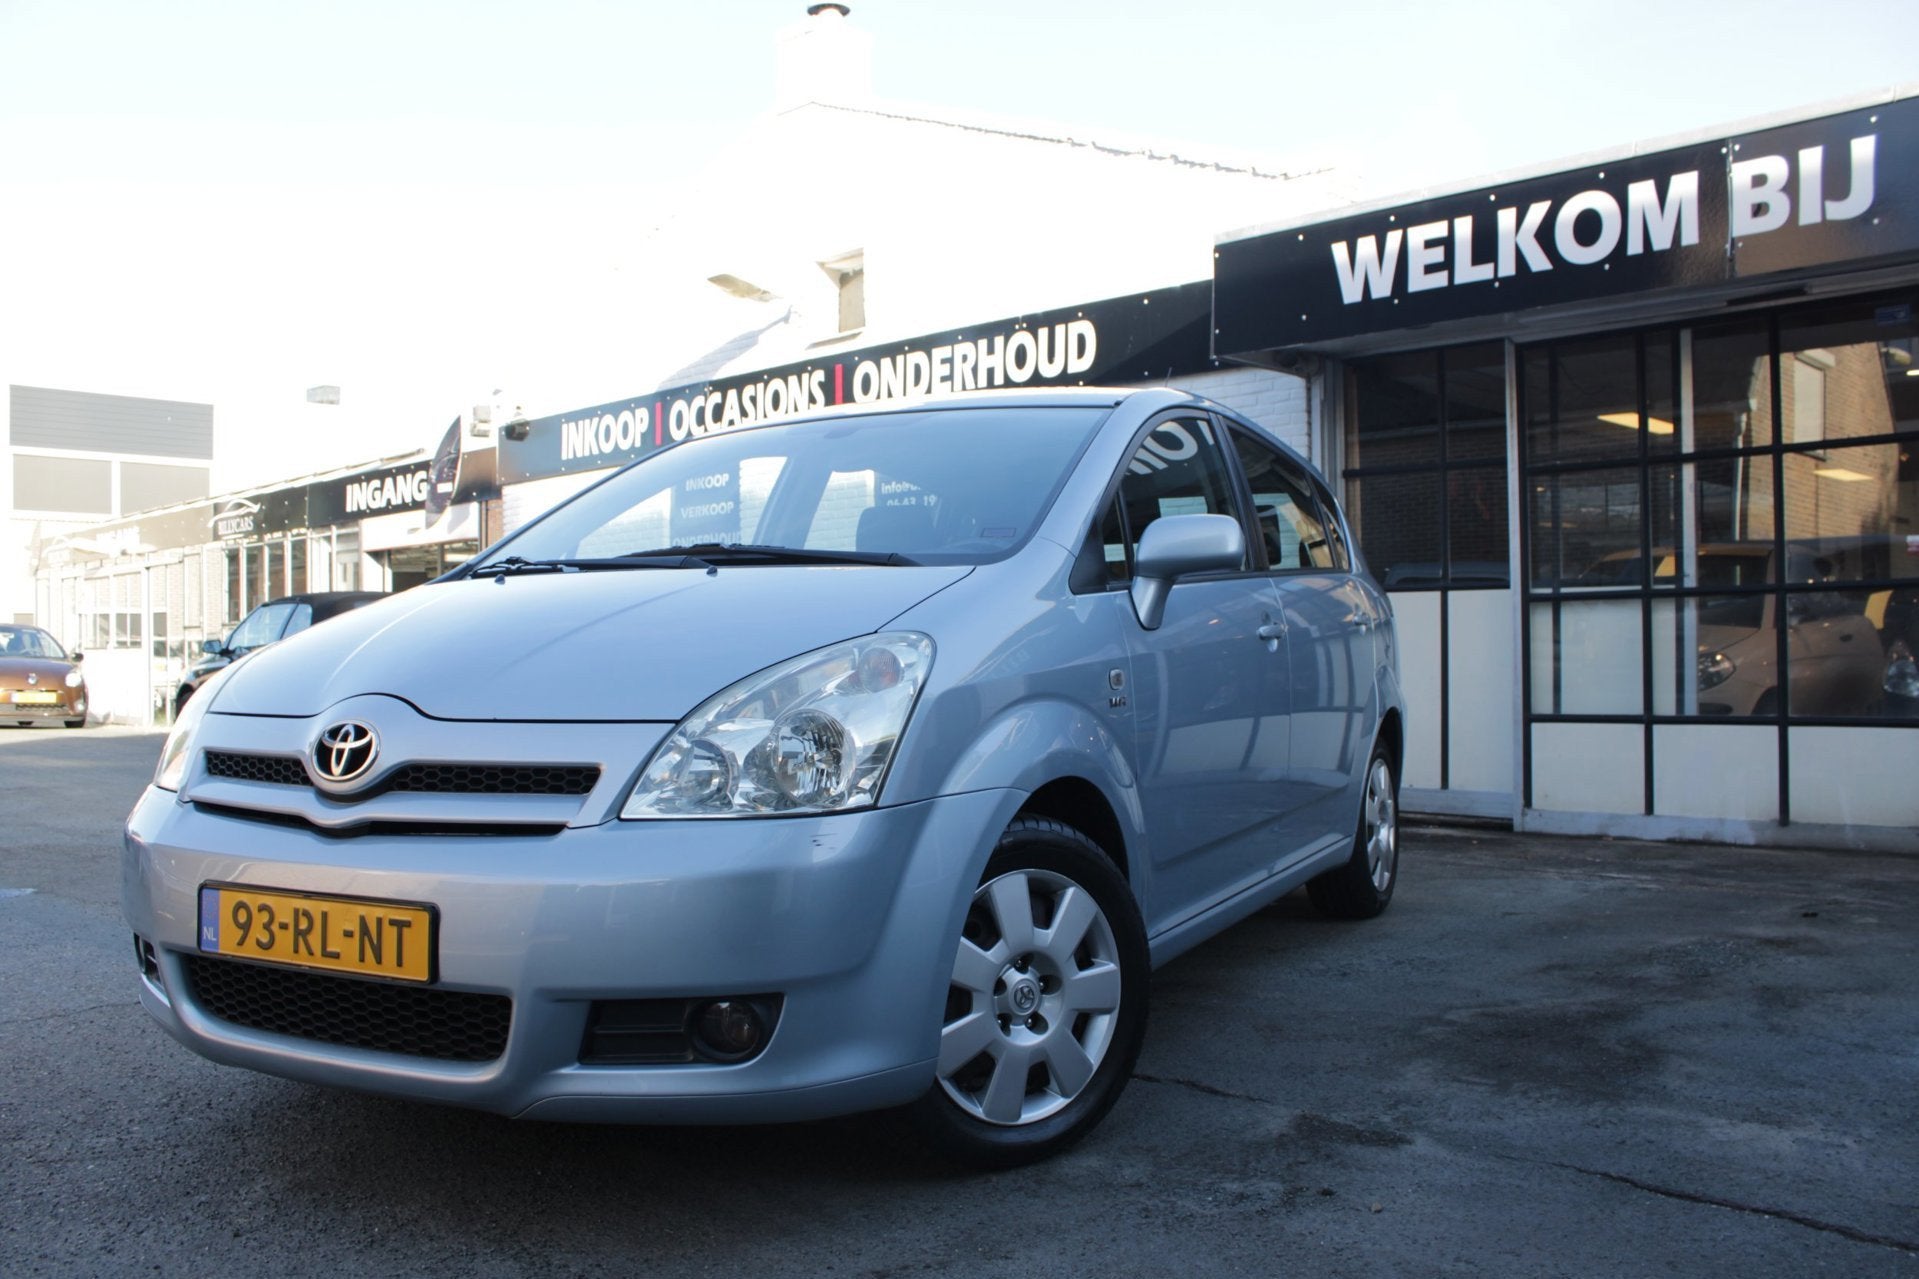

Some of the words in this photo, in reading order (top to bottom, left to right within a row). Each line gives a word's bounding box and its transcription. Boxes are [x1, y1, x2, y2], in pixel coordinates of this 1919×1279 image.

[1331, 171, 1699, 305] WELKOM
[1731, 134, 1877, 238] BIJ
[560, 407, 650, 461] INKOOP
[669, 369, 826, 441] OCCASIONS
[853, 319, 1097, 404] ONDERHOUD
[345, 470, 428, 513] INGANG
[685, 472, 730, 492] INKOOP
[680, 501, 735, 519] VERKOOP
[203, 926, 217, 942] NL
[231, 899, 412, 968] 93-RL-NT
